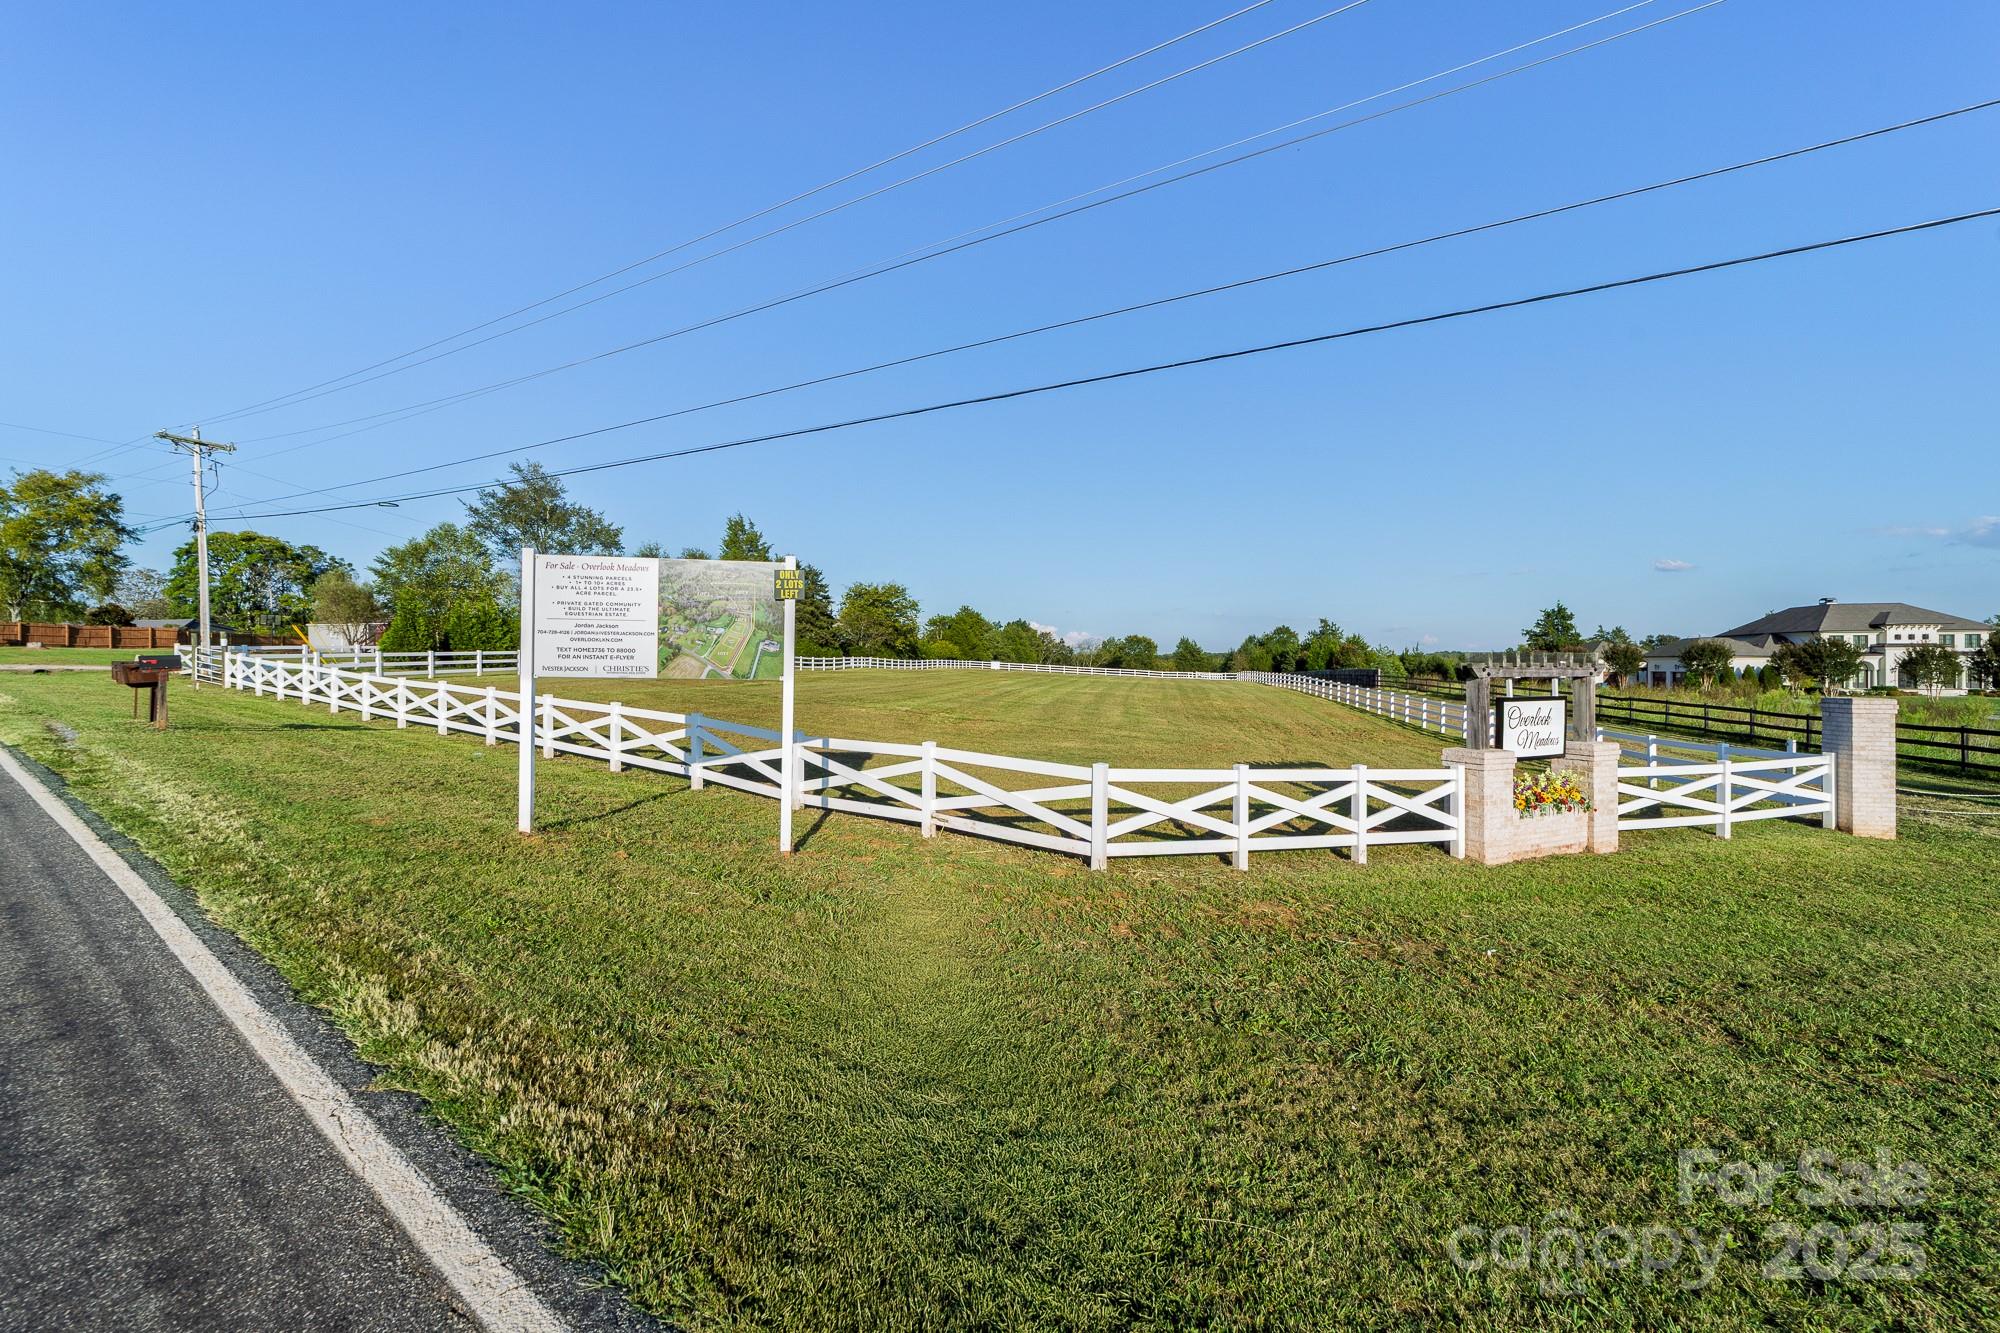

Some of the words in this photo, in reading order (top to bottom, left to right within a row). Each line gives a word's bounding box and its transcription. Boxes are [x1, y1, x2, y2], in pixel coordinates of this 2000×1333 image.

[581, 562, 615, 571] Overlook
[780, 571, 799, 579] ONLY
[784, 580, 803, 588] LOTS
[781, 590, 799, 598] LEFT
[1508, 706, 1552, 729] Overlook
[1517, 729, 1559, 750] Meadows
